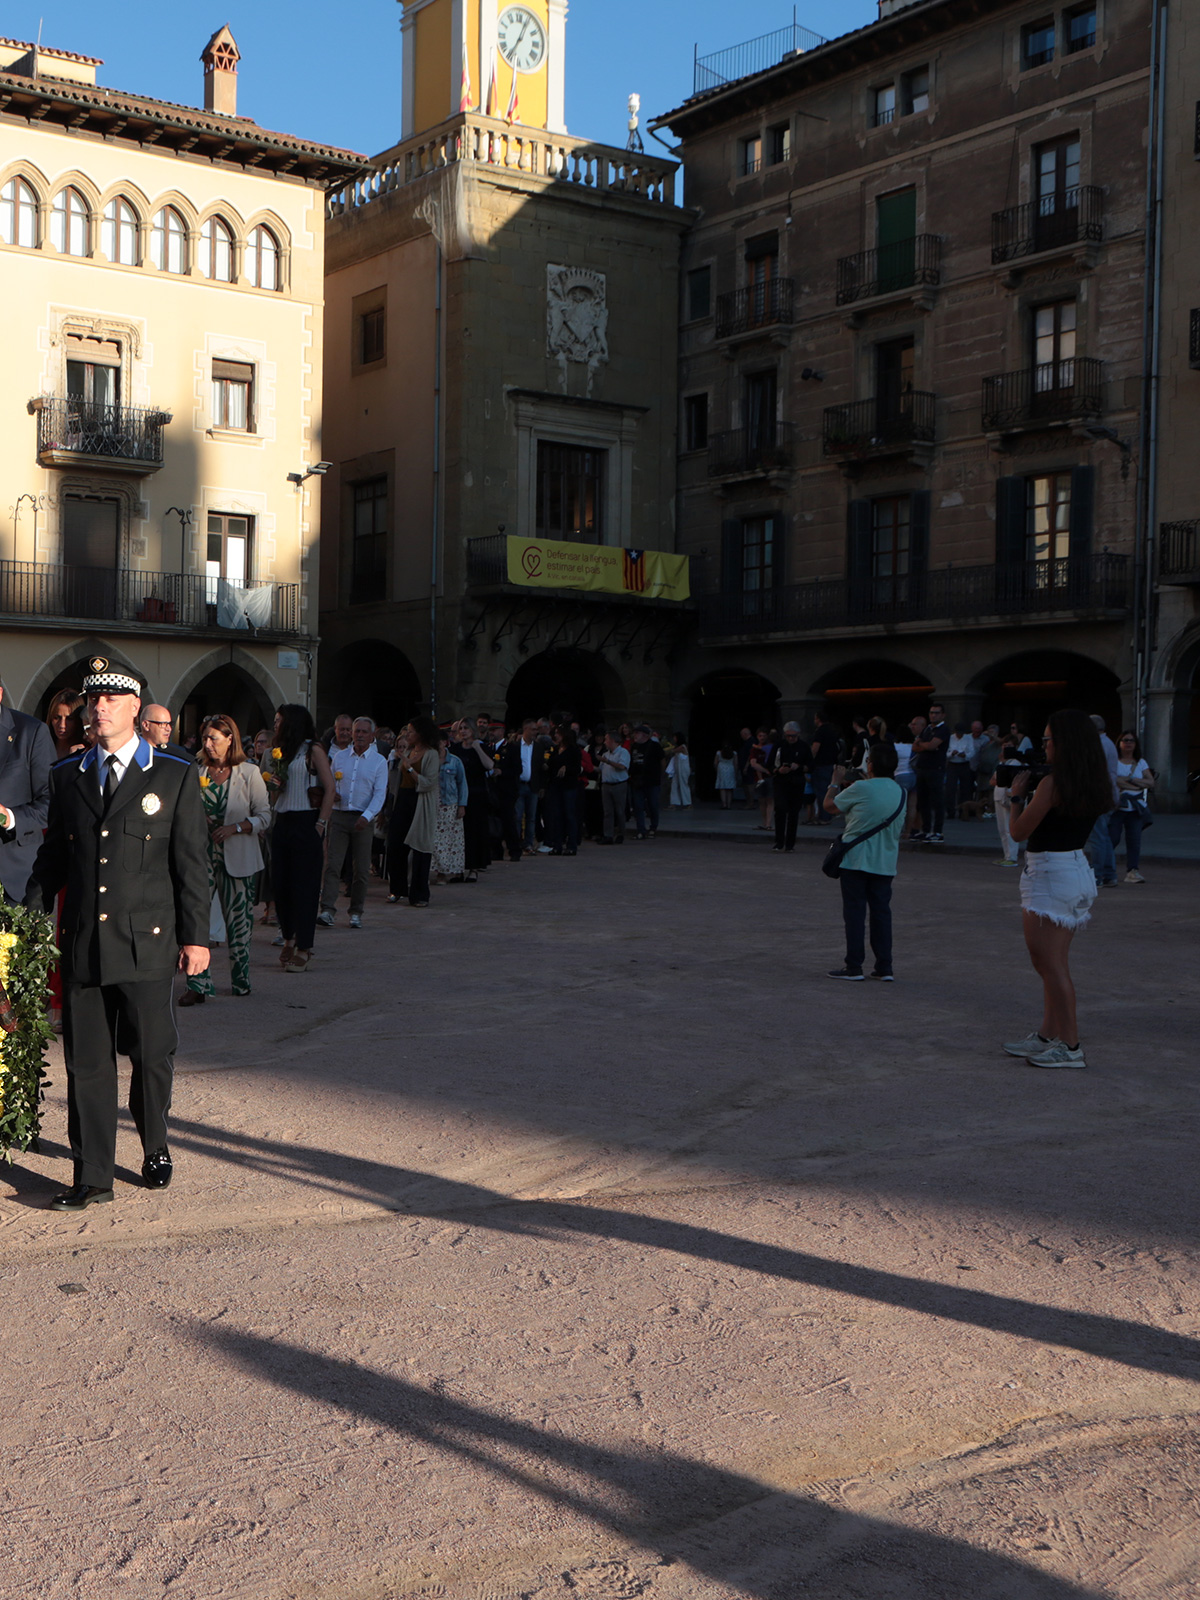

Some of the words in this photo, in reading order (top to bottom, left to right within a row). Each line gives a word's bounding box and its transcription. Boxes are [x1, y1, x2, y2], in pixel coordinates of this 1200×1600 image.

[546, 549, 581, 562] Defensar
[582, 553, 589, 562] la
[546, 563, 575, 572] estimar
[577, 565, 583, 573] el
